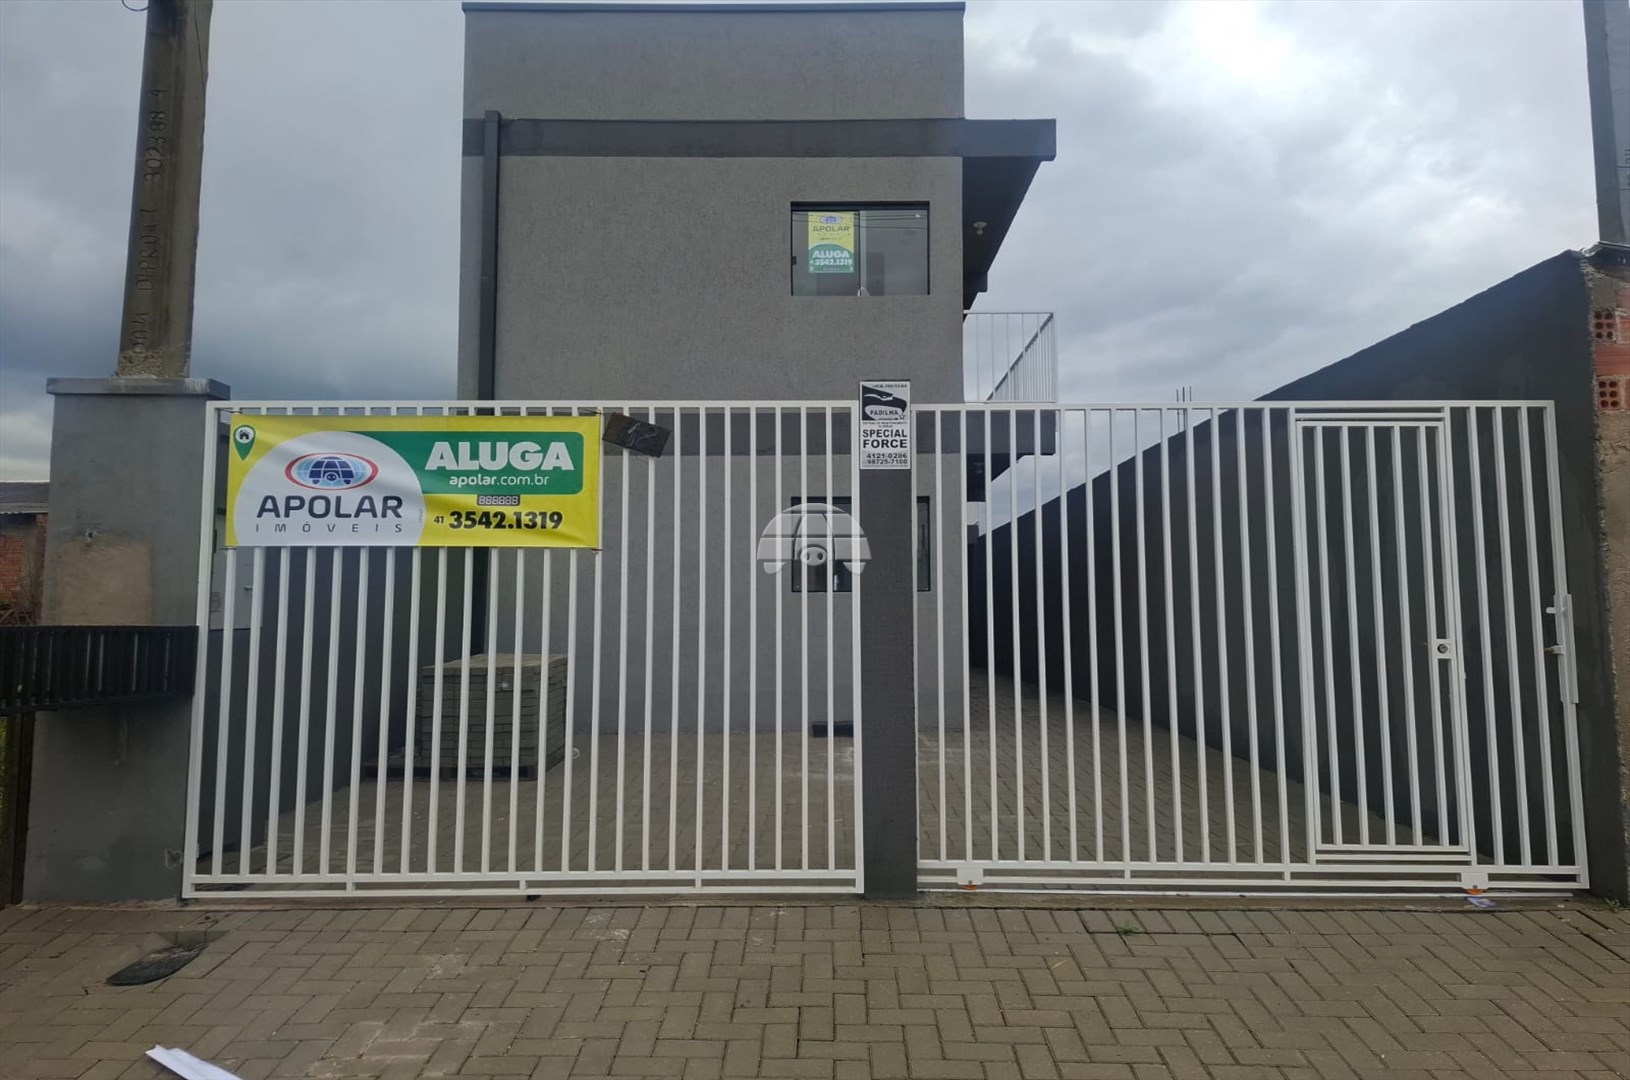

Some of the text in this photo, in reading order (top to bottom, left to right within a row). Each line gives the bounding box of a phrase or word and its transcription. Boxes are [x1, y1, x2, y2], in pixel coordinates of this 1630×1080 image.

[812, 225, 850, 233] APOLAR
[812, 250, 850, 258] ALUGA
[862, 429, 908, 438] SPECIAL
[862, 439, 908, 449] FORCE
[424, 441, 575, 471] ALUGA
[449, 473, 550, 488] apolar.com.br
[256, 494, 403, 519] APOLAR
[433, 515, 445, 524] 41
[449, 511, 563, 529] 3542.1319
